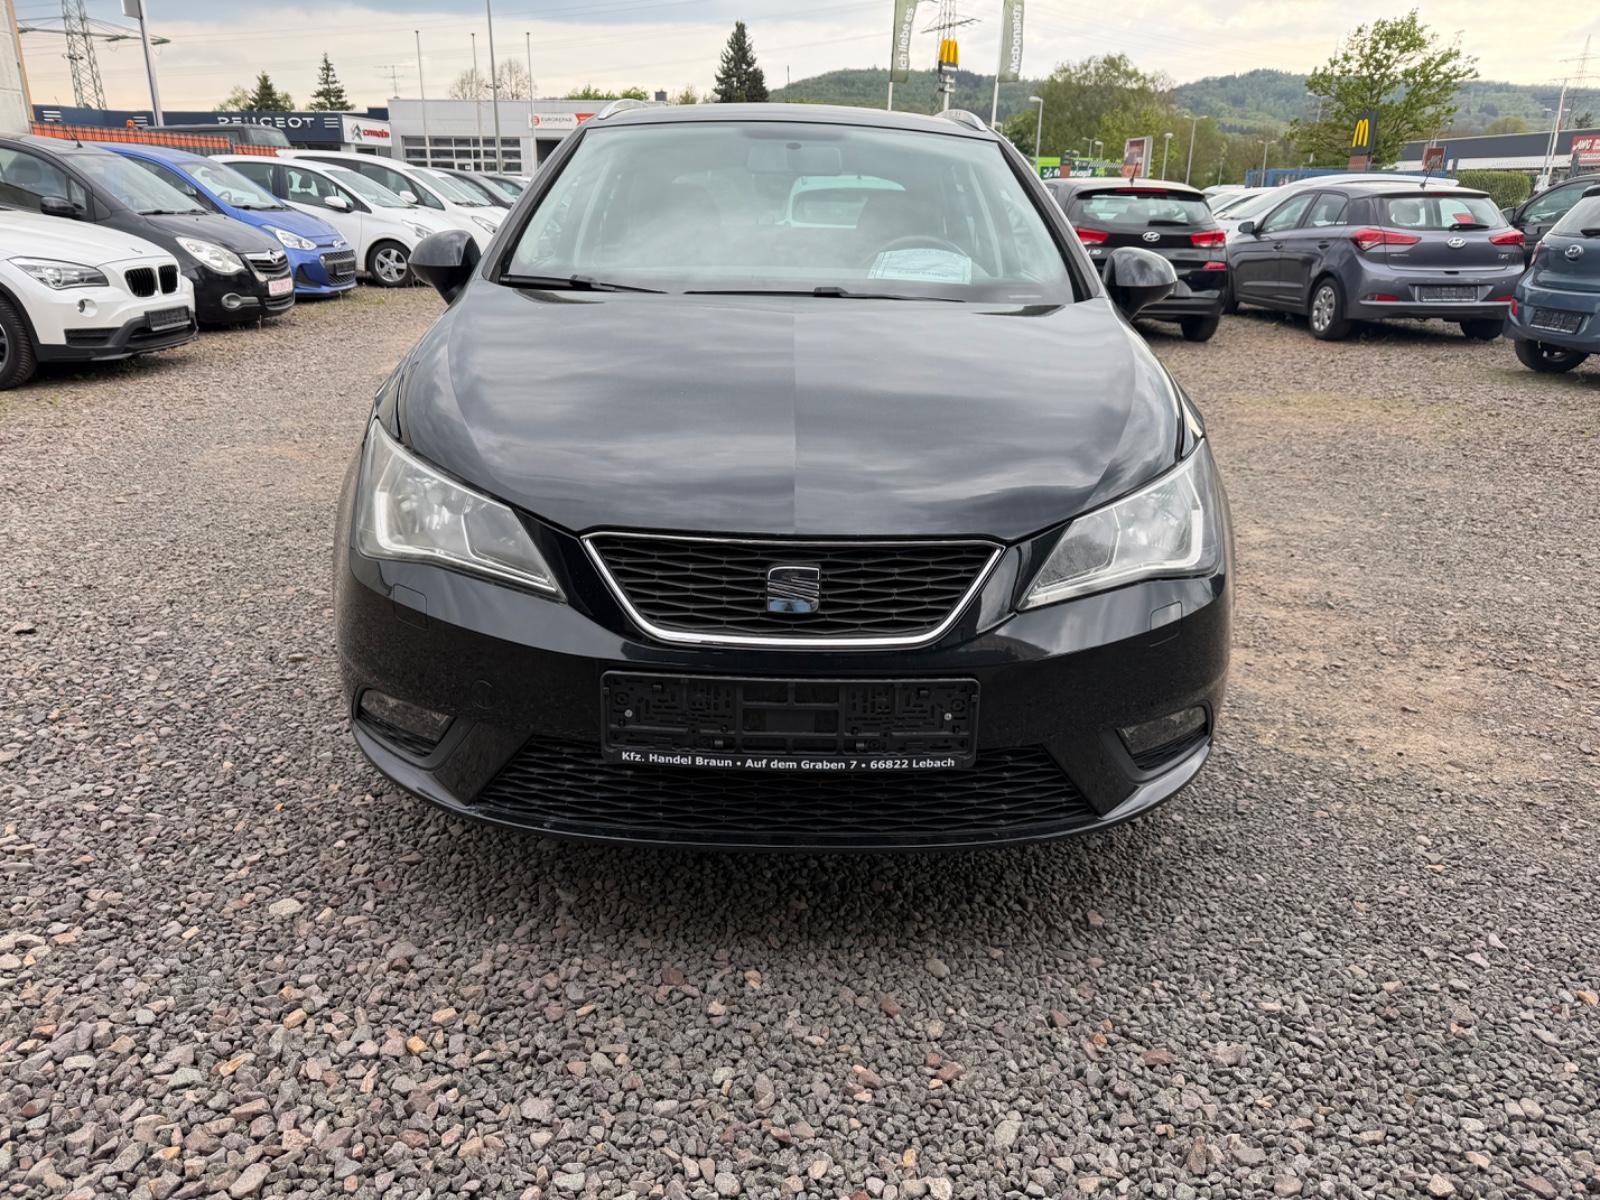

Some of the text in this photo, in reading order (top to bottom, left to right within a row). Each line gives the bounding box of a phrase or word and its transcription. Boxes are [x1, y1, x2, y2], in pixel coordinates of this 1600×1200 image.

[217, 116, 315, 129] PEUGEOT
[621, 751, 955, 770] Kfz. Handel Braun Auf dem Graben 7 66822 Lebach
